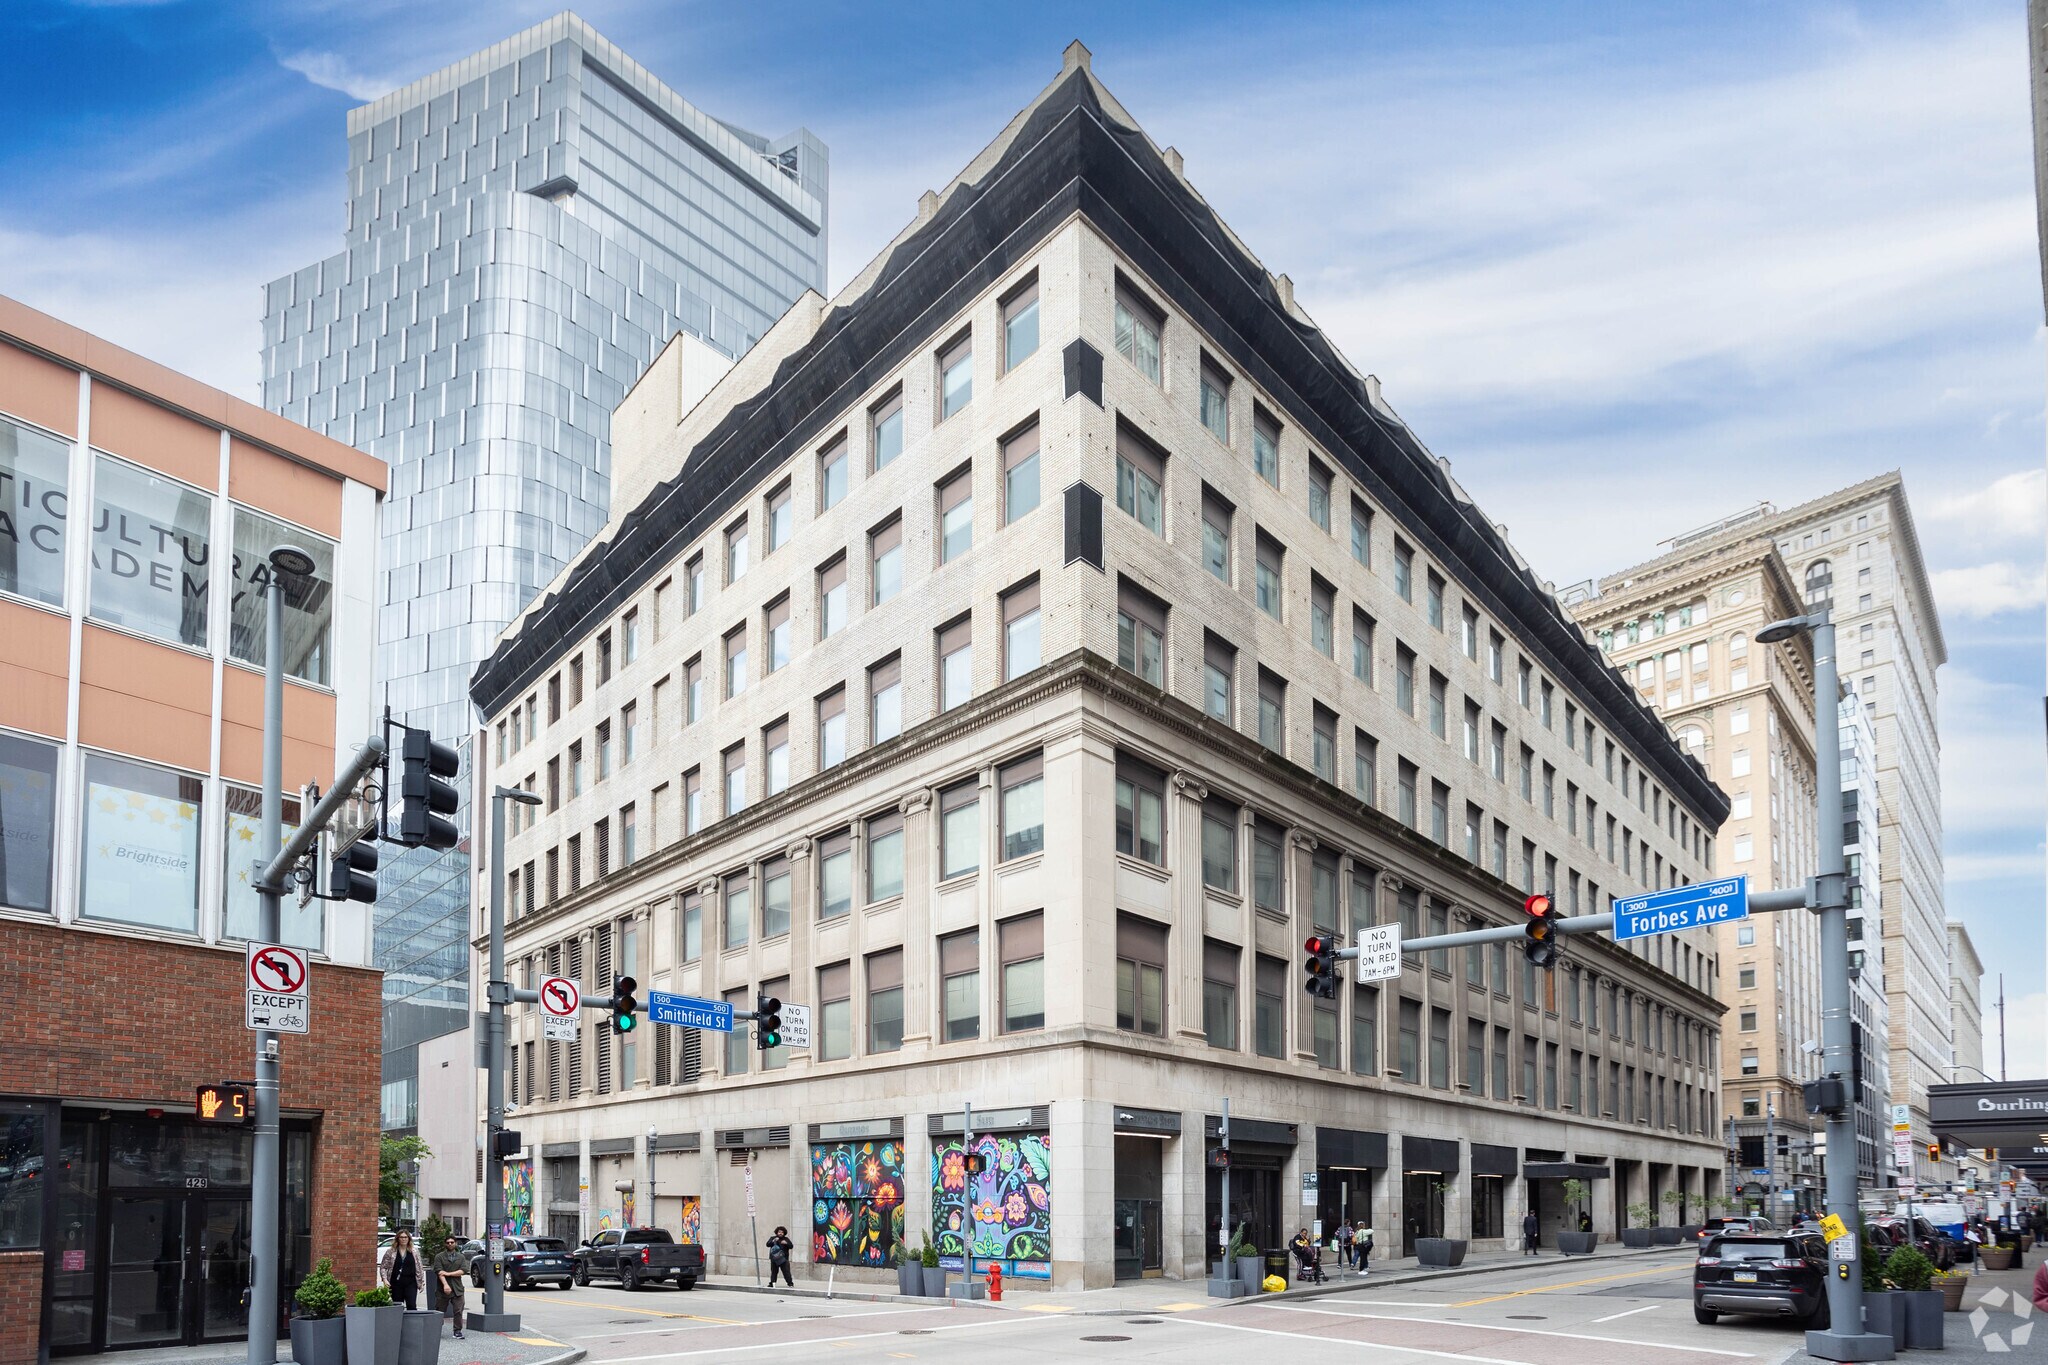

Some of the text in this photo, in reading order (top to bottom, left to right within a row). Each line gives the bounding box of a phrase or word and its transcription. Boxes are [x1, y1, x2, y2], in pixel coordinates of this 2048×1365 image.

[0, 510, 246, 613] ACDEMY
[115, 846, 188, 869] Brightside
[1631, 902, 1729, 934] Forbes Ave
[1371, 930, 1387, 941] NO
[1367, 941, 1392, 953] TURN
[1362, 952, 1397, 966] ON RED
[252, 994, 304, 1010] EXCEPT
[656, 995, 671, 1004] 500
[713, 1004, 727, 1013] 500
[788, 1007, 801, 1016] NO
[545, 1016, 574, 1027] EXCEPT
[657, 1007, 726, 1029] Smithfield St
[785, 1016, 804, 1025] TURN
[780, 1025, 808, 1035] ON RED
[232, 1094, 244, 1117] 5
[186, 1178, 207, 1188] 429
